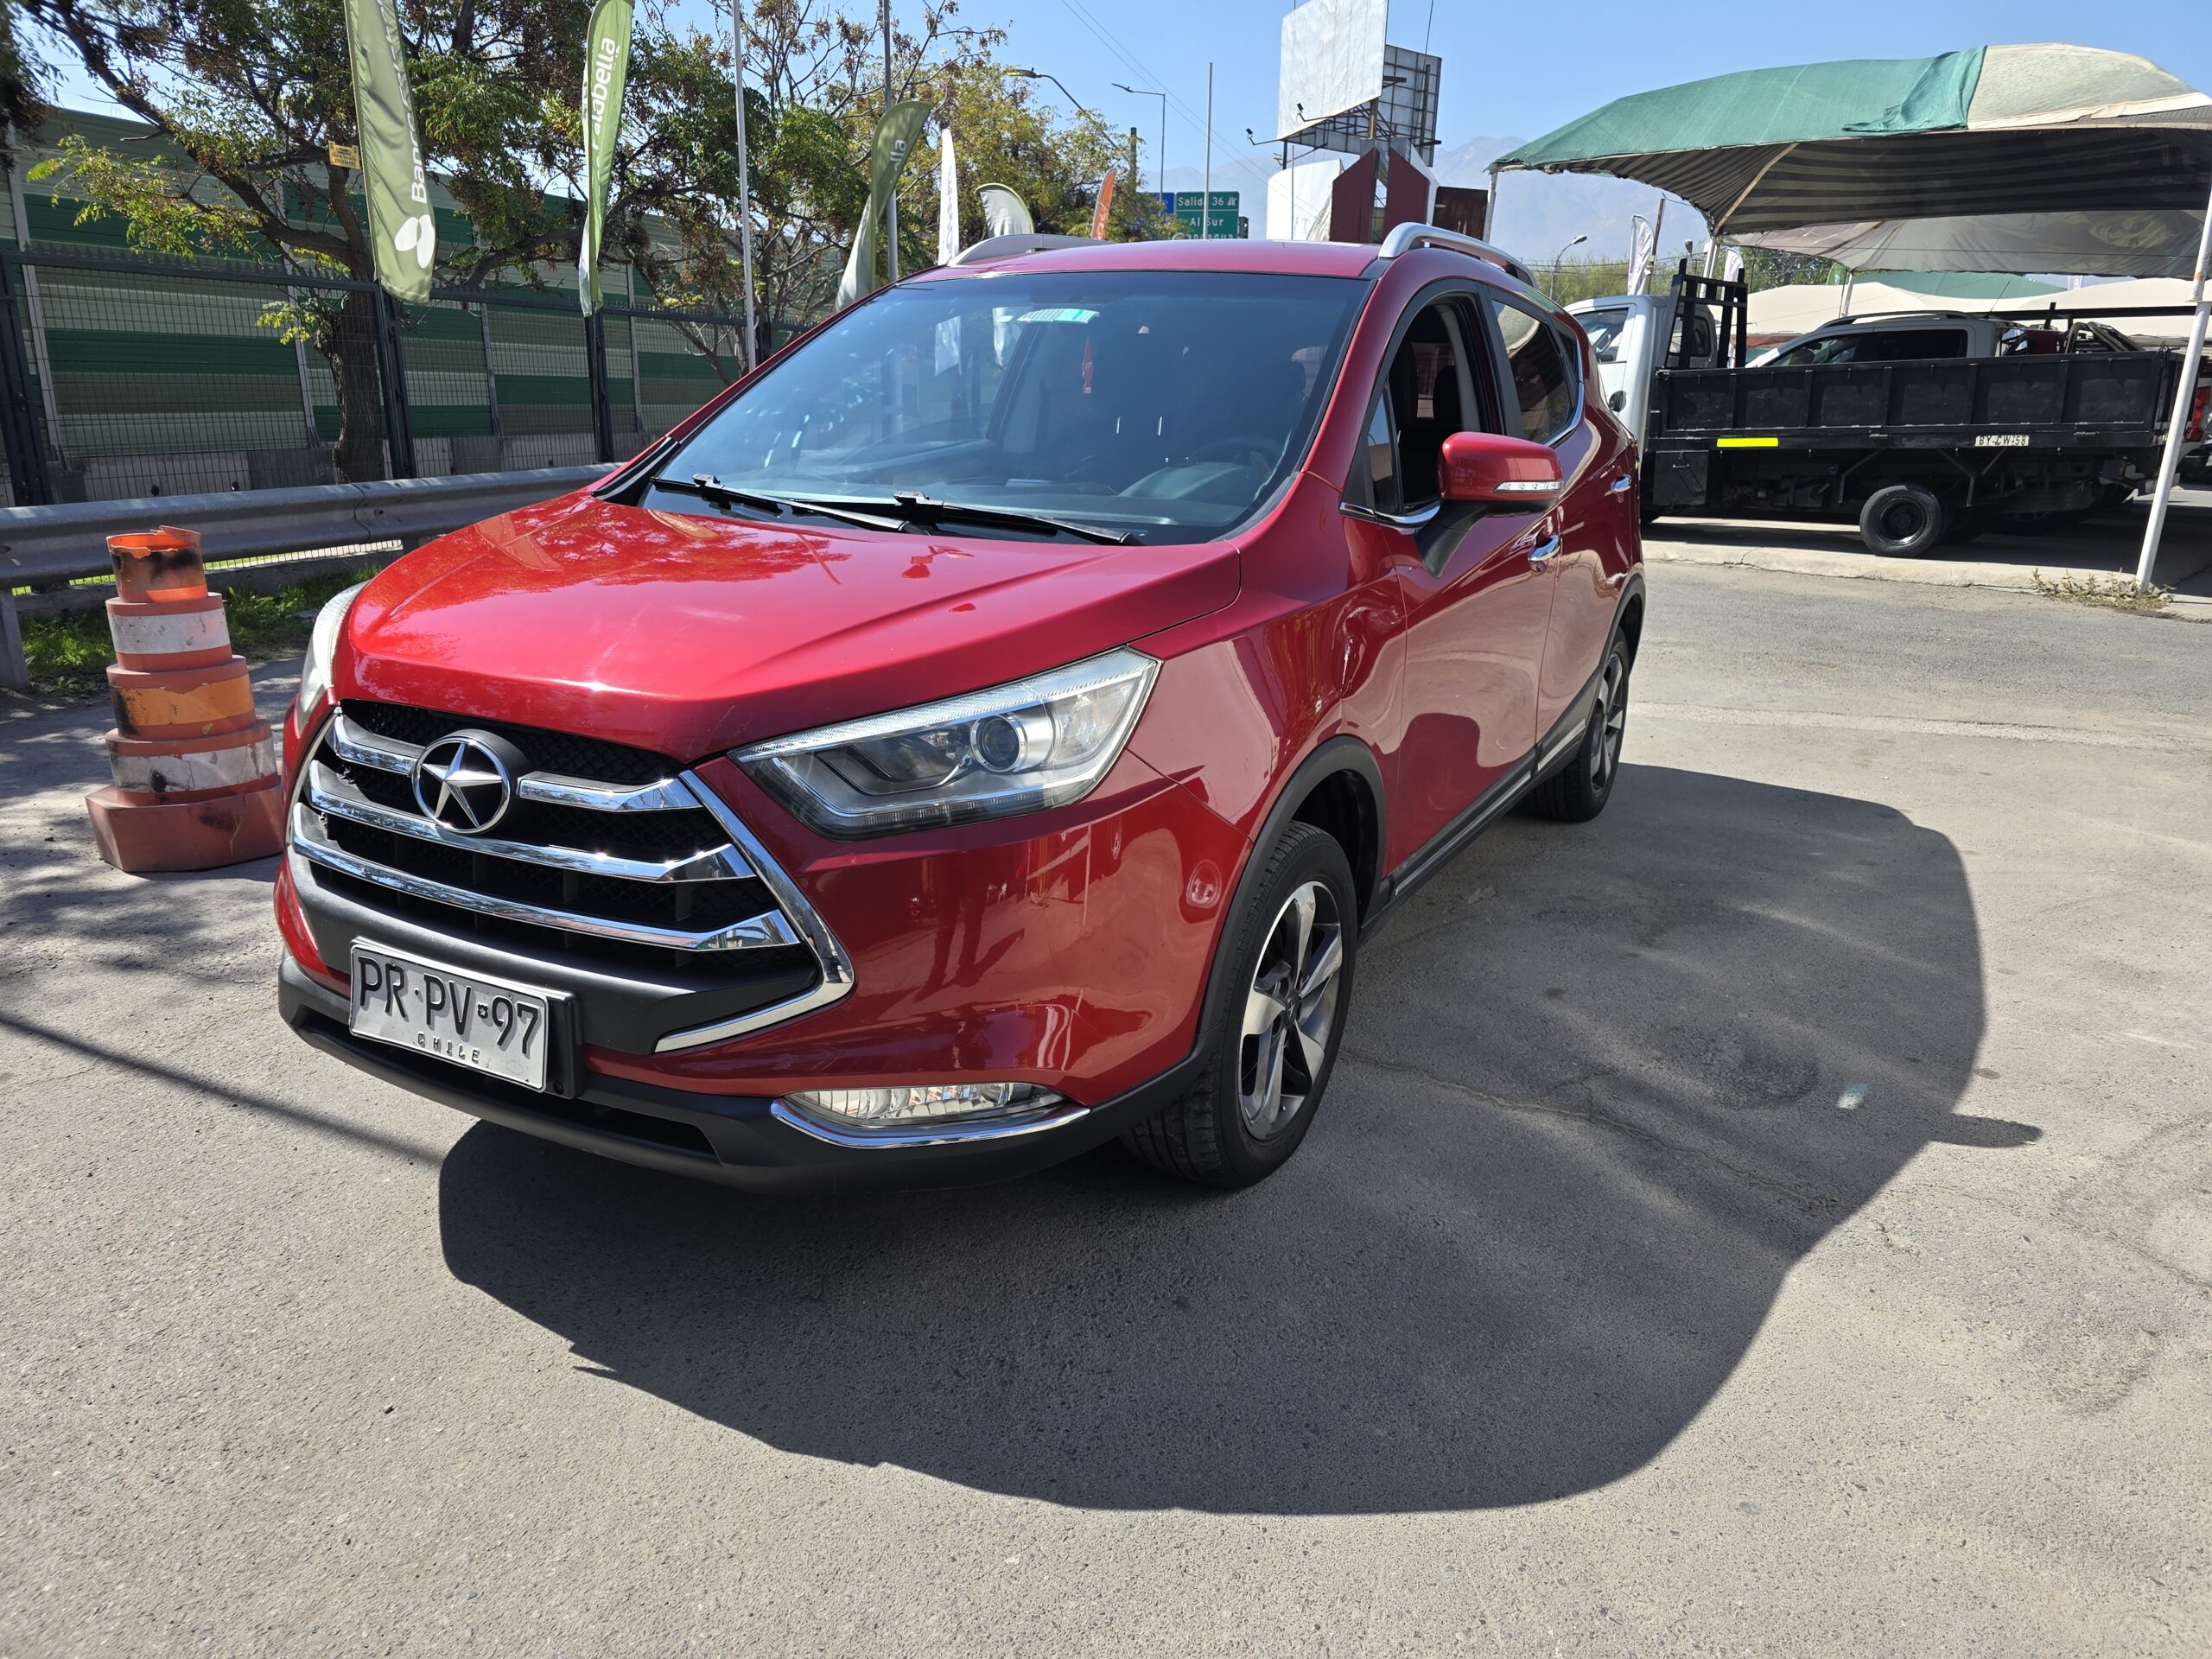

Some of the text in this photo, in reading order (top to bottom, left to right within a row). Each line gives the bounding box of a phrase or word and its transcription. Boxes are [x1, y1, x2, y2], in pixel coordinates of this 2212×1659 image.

[1178, 196, 1224, 207] Salid 36
[1189, 217, 1200, 226] Al
[417, 1031, 480, 1065] CHILE
